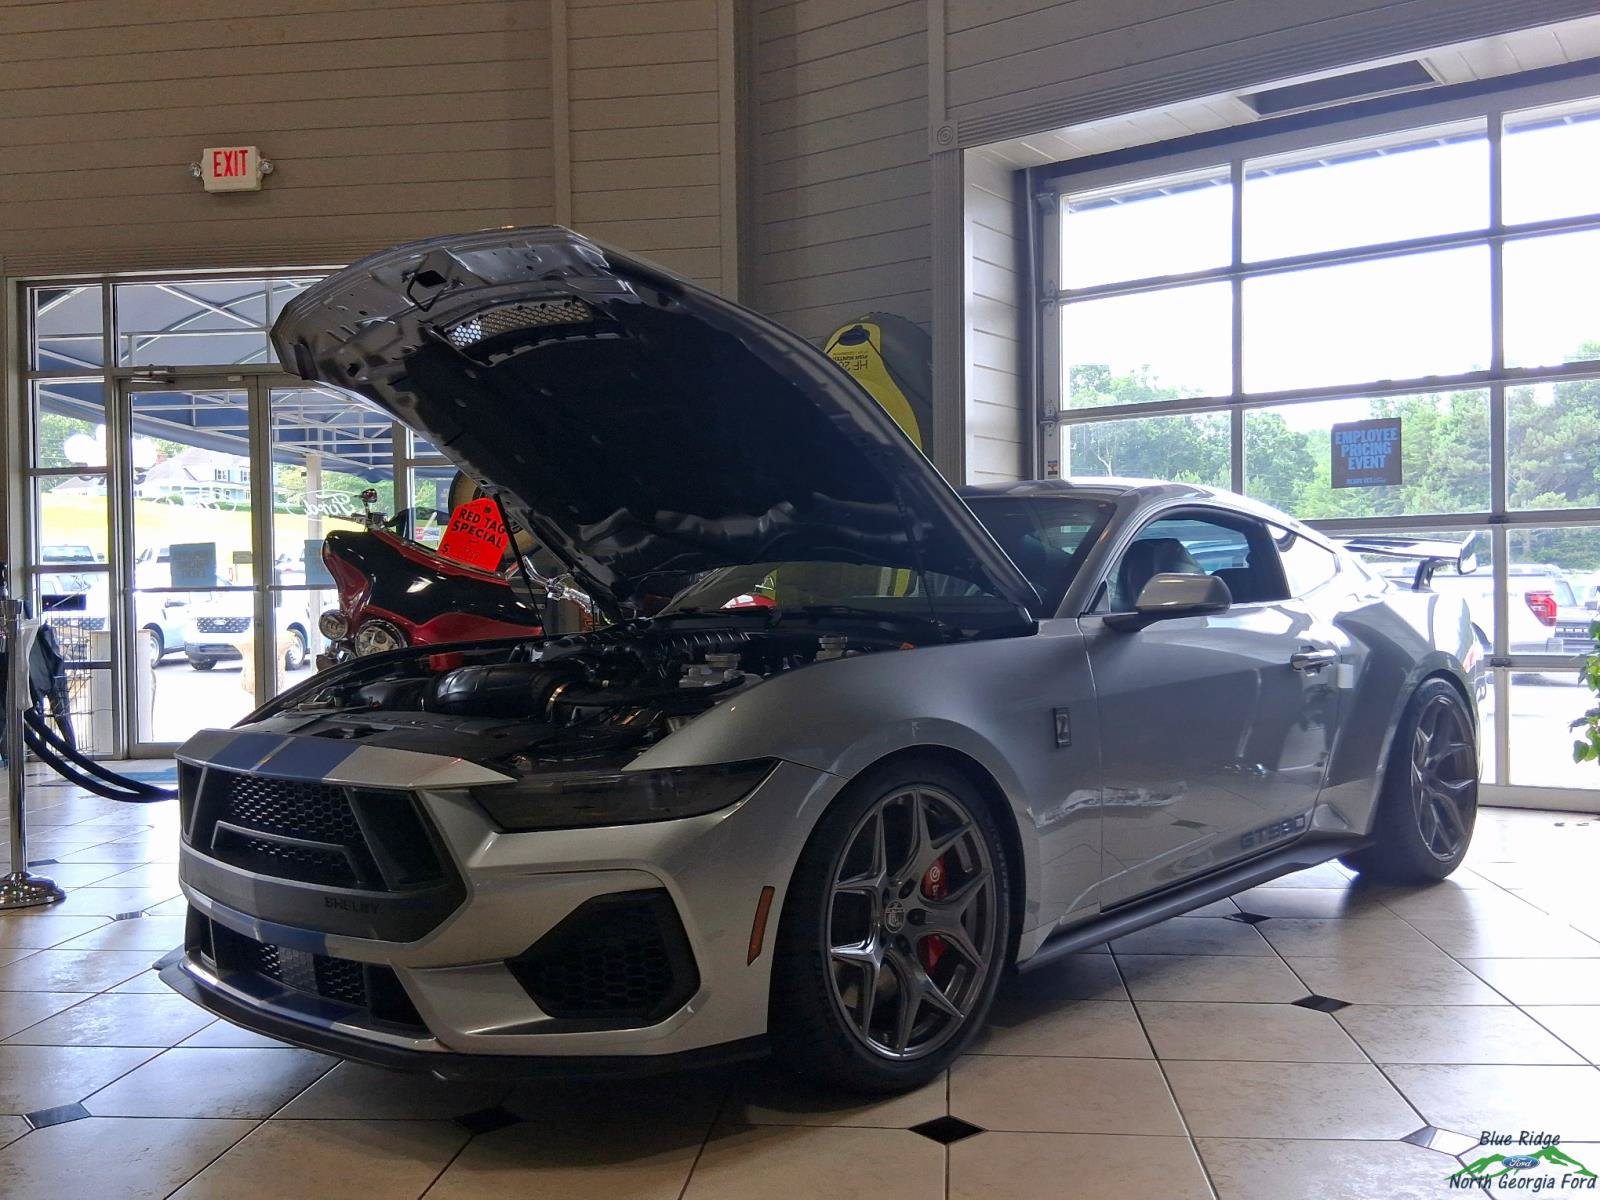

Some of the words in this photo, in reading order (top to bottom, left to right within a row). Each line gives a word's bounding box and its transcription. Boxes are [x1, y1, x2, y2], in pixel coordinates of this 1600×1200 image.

[213, 149, 248, 178] EXIT
[853, 360, 868, 371] HF
[1335, 427, 1398, 444] EMPLOYEE
[1341, 442, 1392, 457] PRICING
[1348, 455, 1386, 470] EVENT
[460, 508, 481, 524] RED
[485, 518, 506, 534] TAG
[451, 521, 503, 549] SPECIAL
